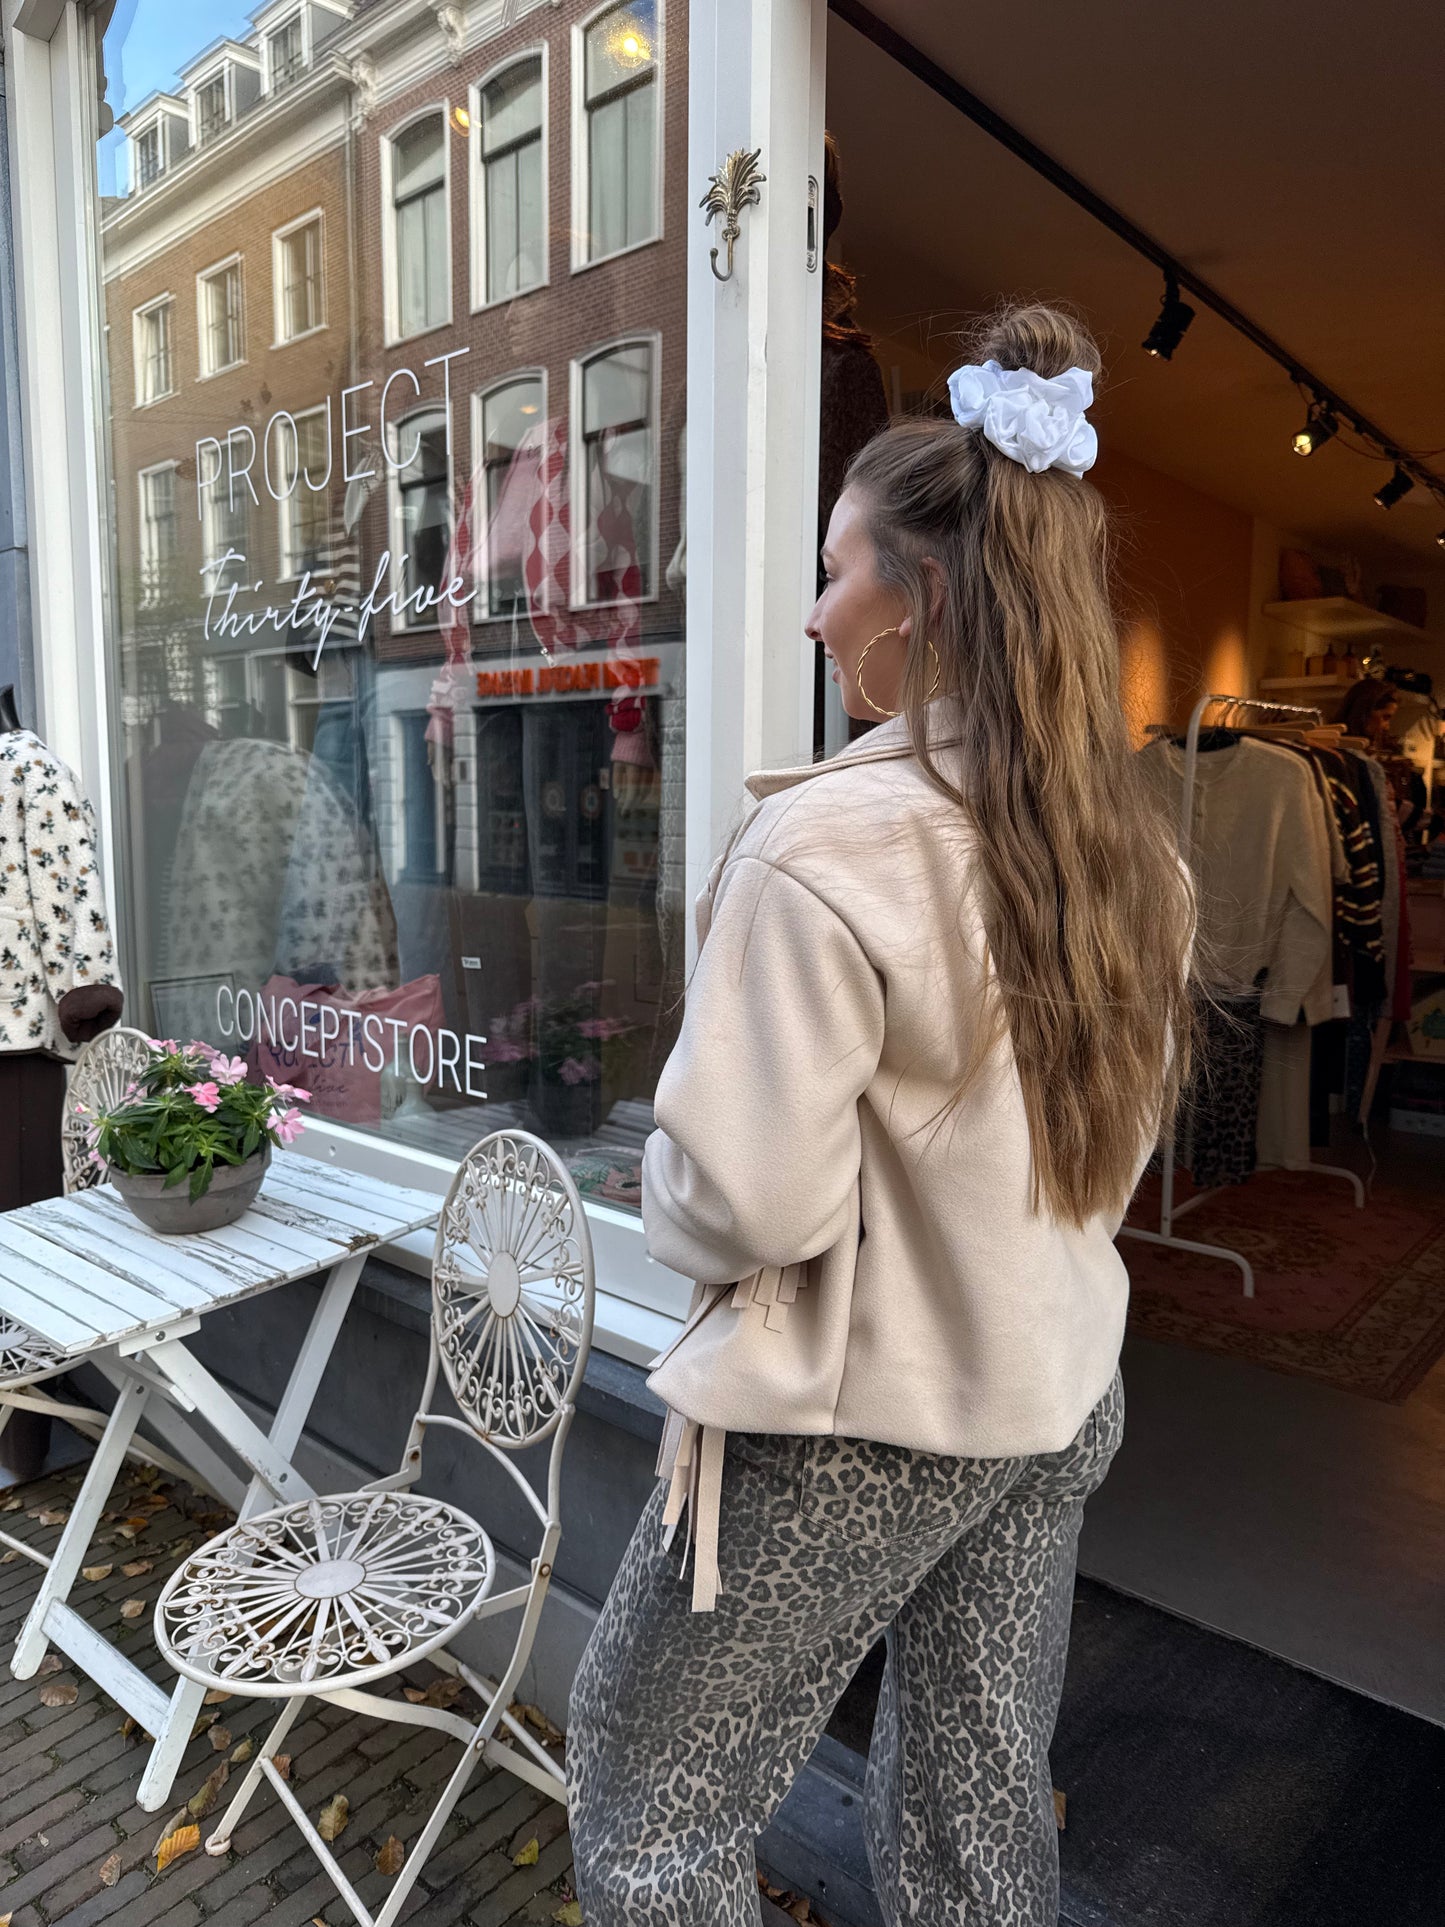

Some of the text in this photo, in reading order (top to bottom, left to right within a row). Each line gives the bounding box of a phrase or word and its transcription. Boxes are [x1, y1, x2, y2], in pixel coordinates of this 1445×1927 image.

[196, 347, 470, 521] PROJECT
[200, 547, 478, 672] Thirty-five
[216, 984, 488, 1099] CONCEPTSTORE
